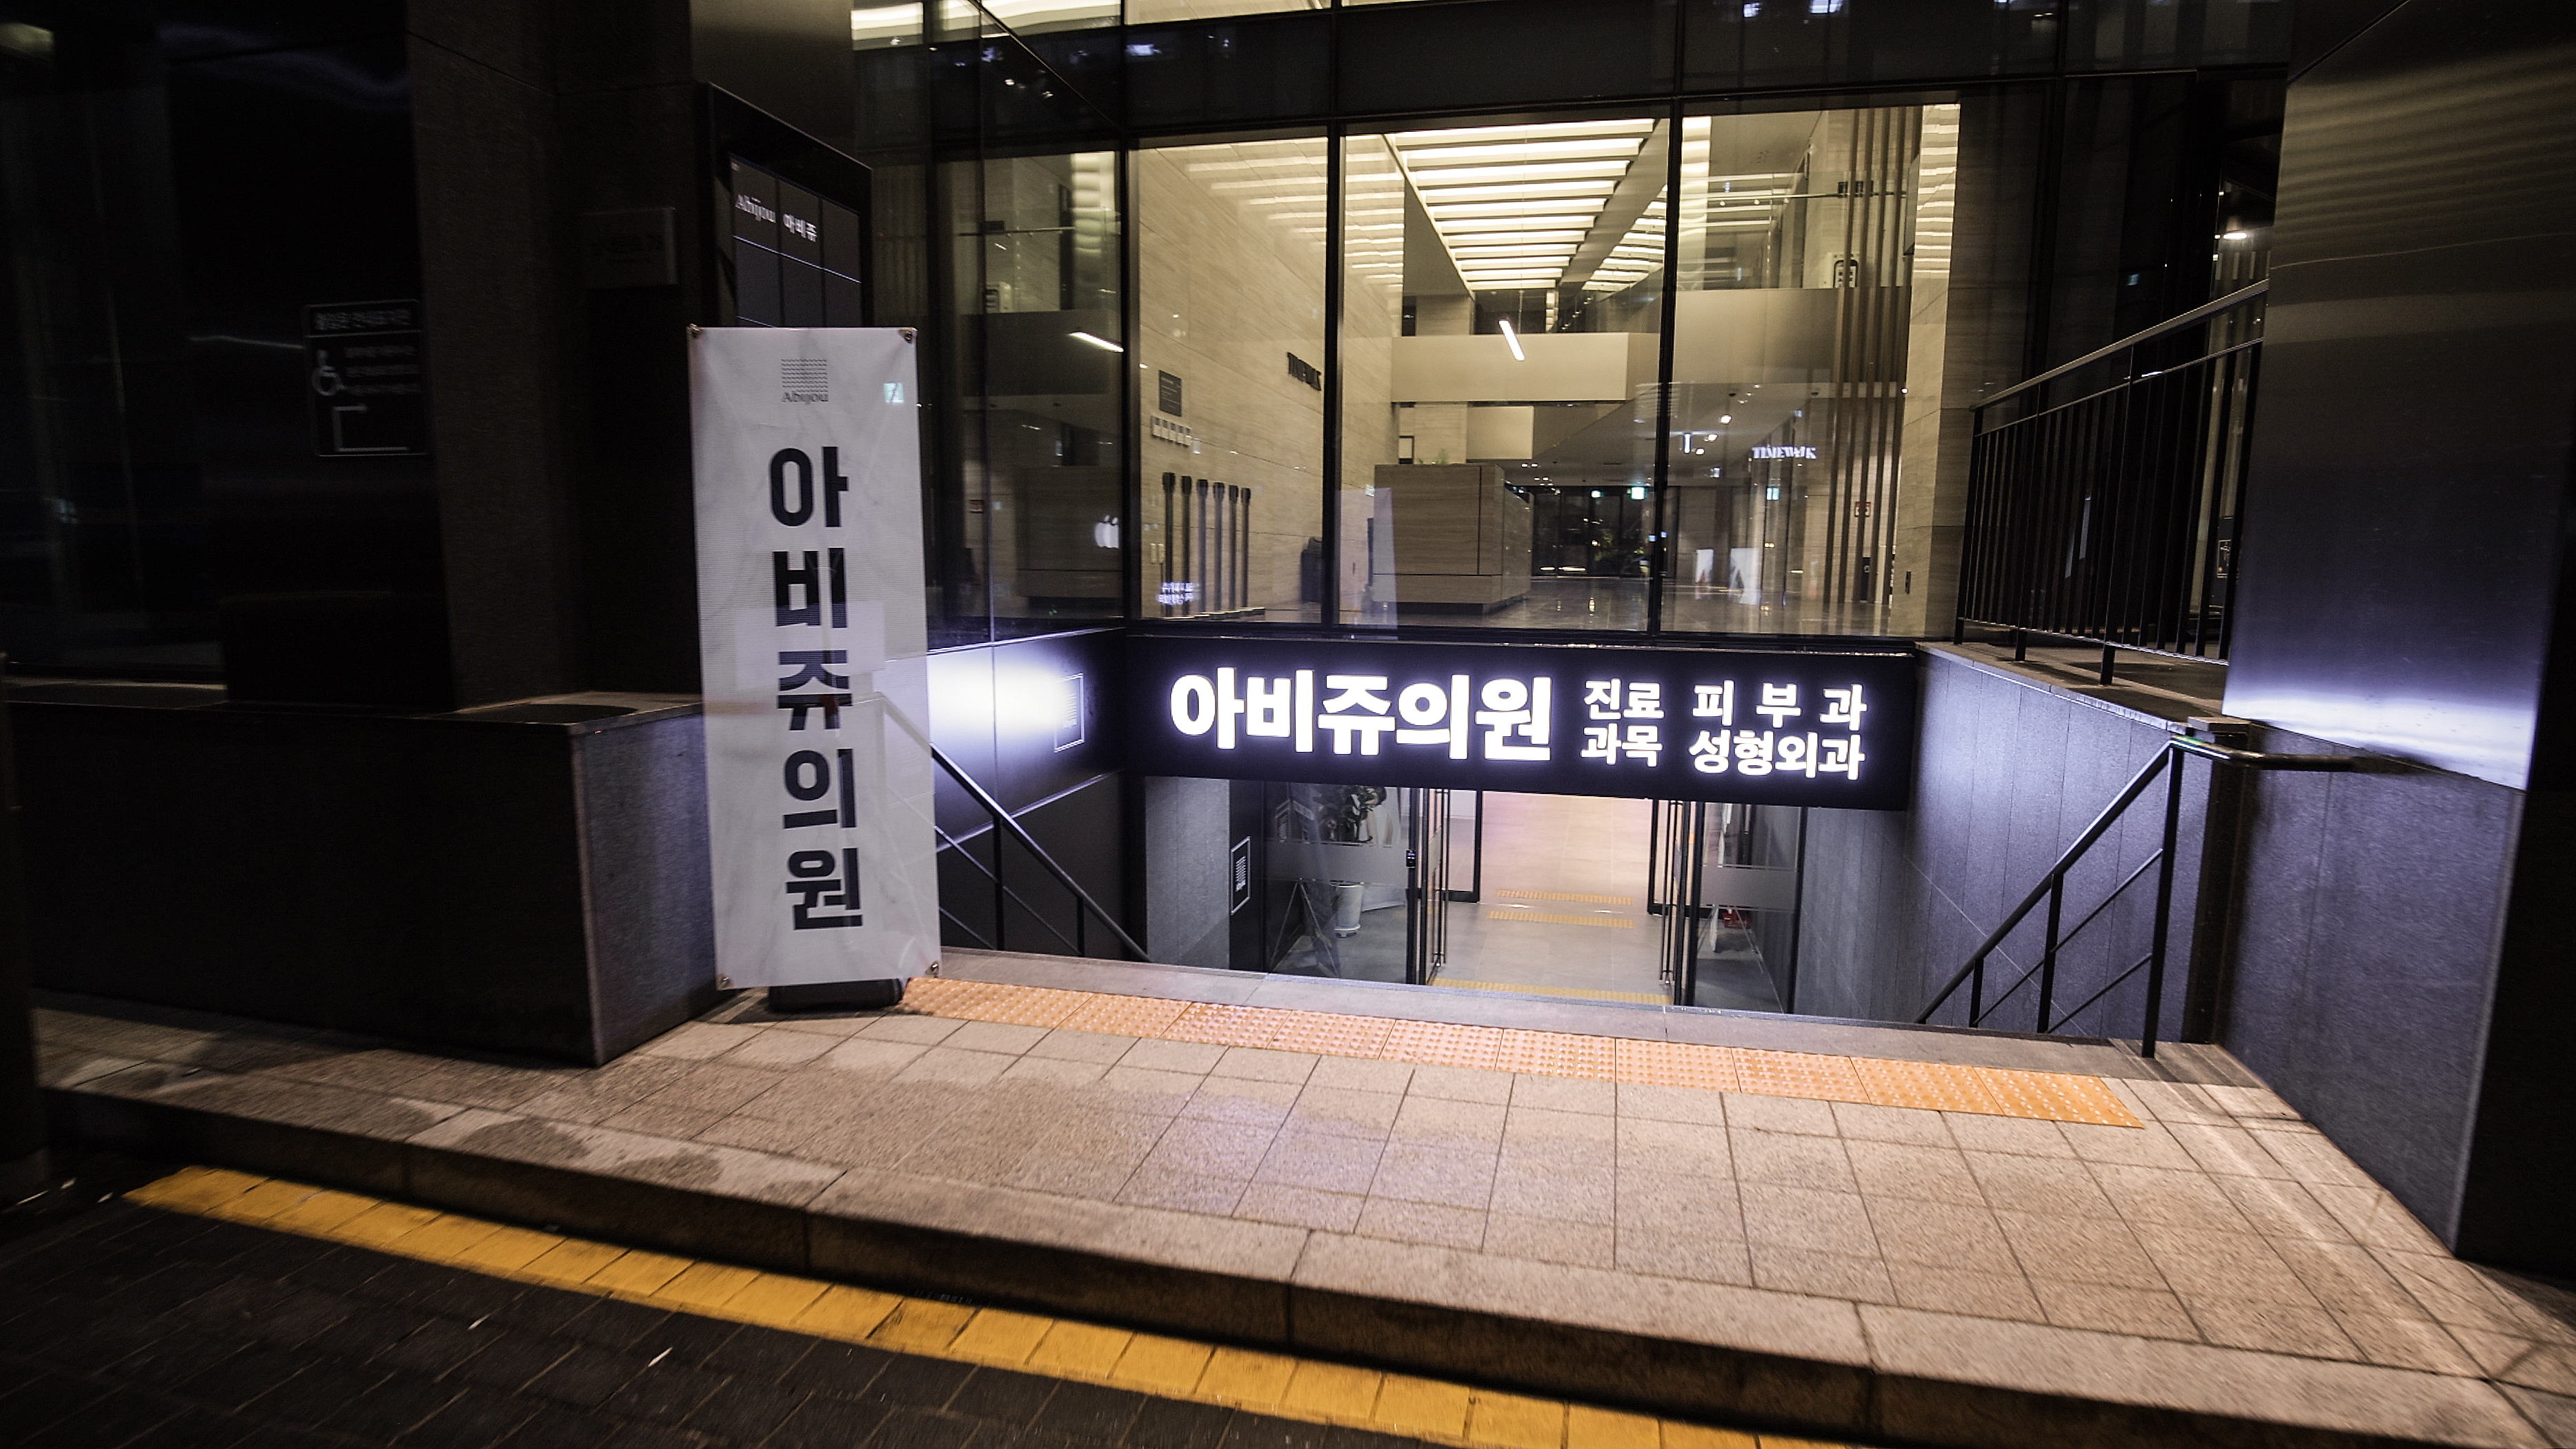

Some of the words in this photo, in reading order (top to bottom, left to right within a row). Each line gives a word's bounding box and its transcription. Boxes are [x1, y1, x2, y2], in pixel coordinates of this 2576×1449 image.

[782, 213, 818, 242] 아비쥬
[769, 446, 863, 930] 아비쥬의원
[1171, 667, 1552, 760] 아비쥬의원
[1583, 678, 1665, 720] 진료
[1581, 722, 1663, 767] 과목
[1689, 729, 1865, 781] 성형외과
